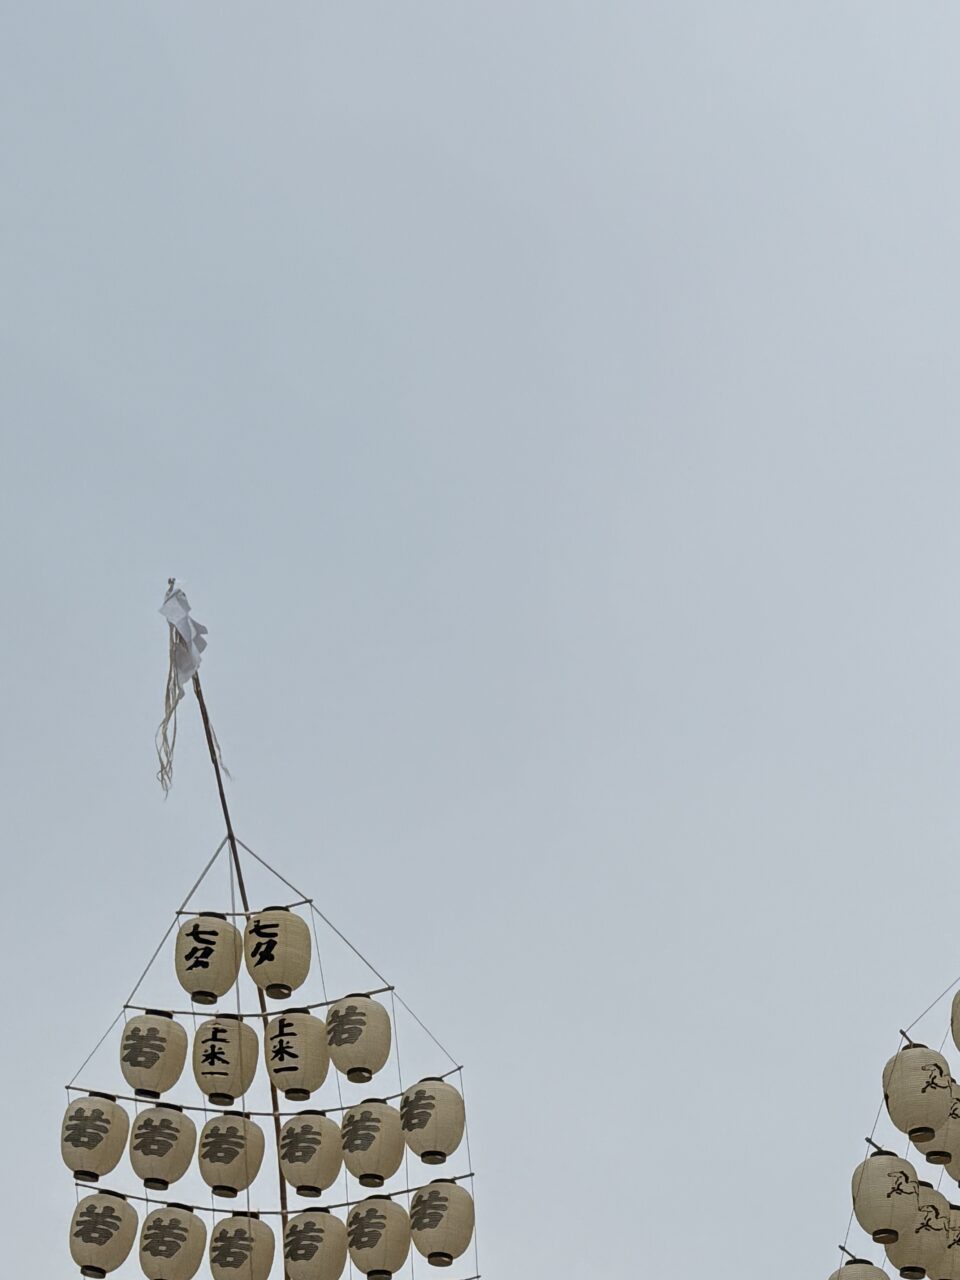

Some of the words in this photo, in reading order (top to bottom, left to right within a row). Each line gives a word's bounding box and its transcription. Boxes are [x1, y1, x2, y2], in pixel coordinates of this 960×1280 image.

[185, 924, 218, 970] 七夕
[249, 920, 279, 967] 七夕
[201, 1027, 229, 1076] 上米一
[270, 1018, 298, 1073] 上米一
